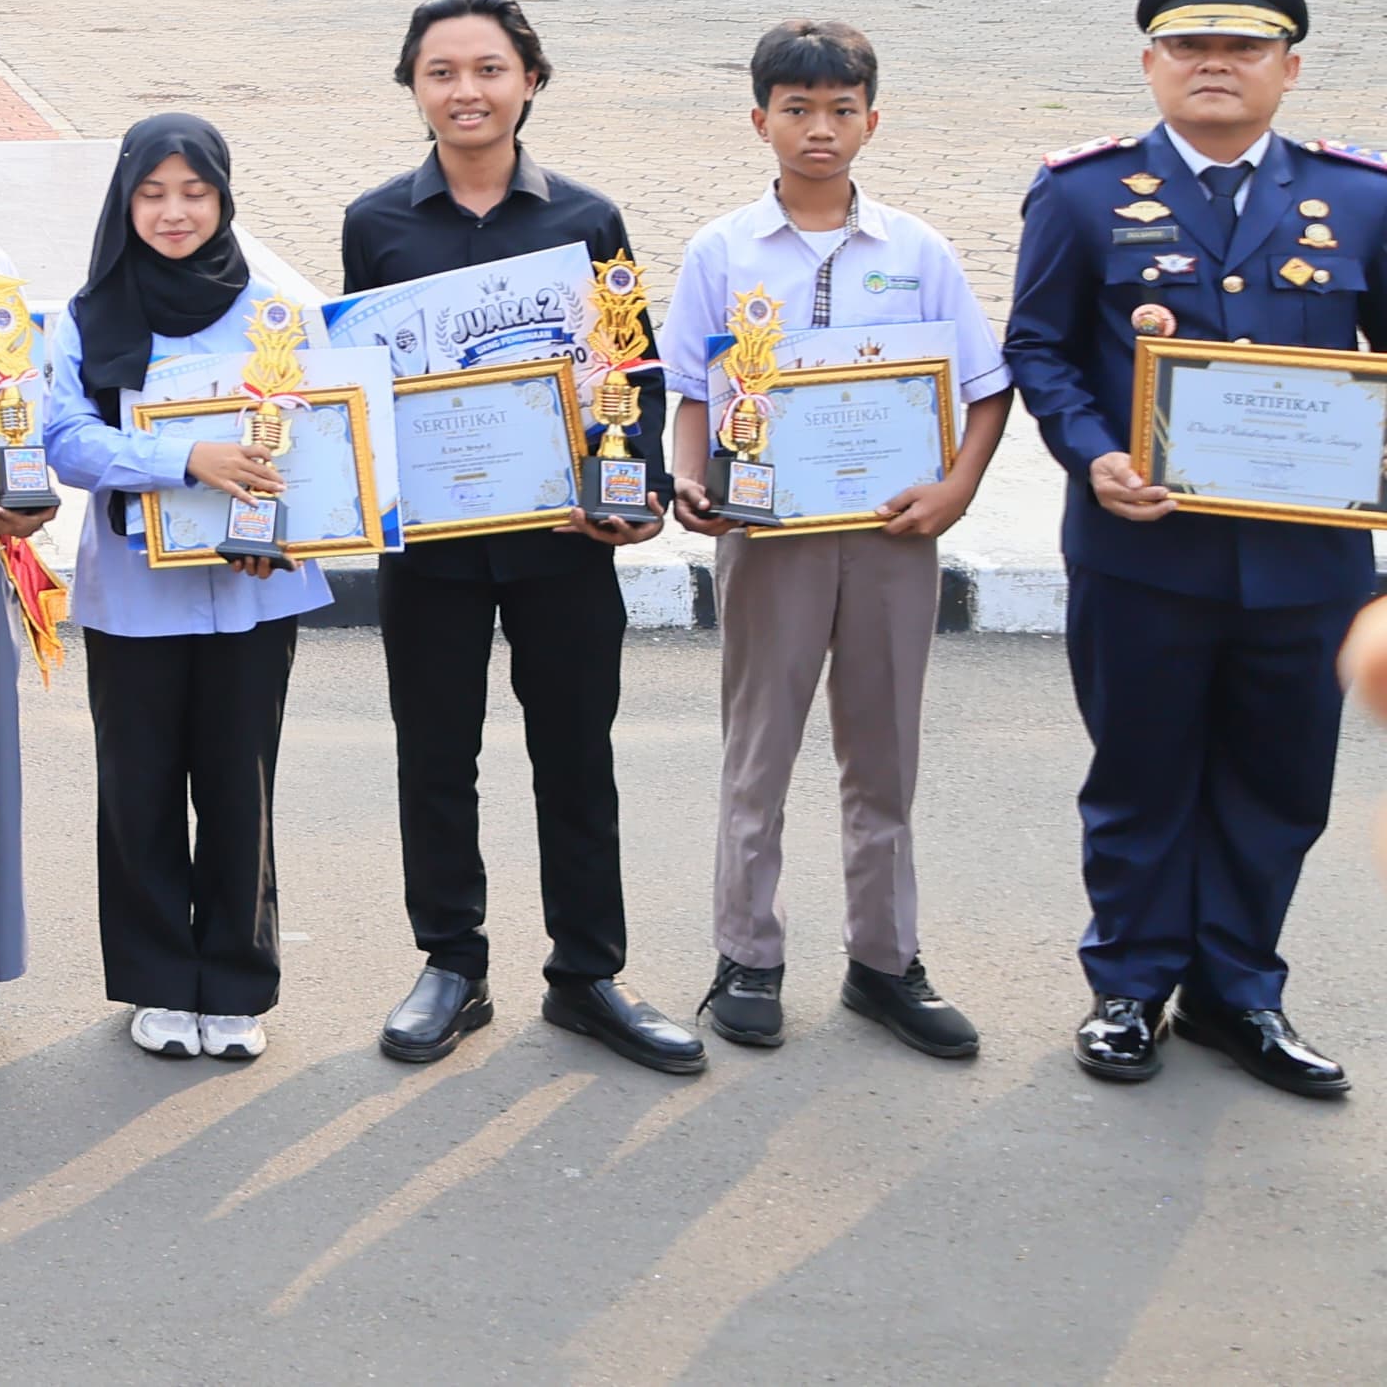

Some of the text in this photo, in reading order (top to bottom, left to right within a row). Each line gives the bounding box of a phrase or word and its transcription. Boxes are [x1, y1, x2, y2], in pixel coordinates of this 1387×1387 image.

[1222, 392, 1332, 414] SERTIFIKAT
[412, 410, 508, 435] SERTIFIKAT
[804, 406, 891, 427] SERTIFIKAT
